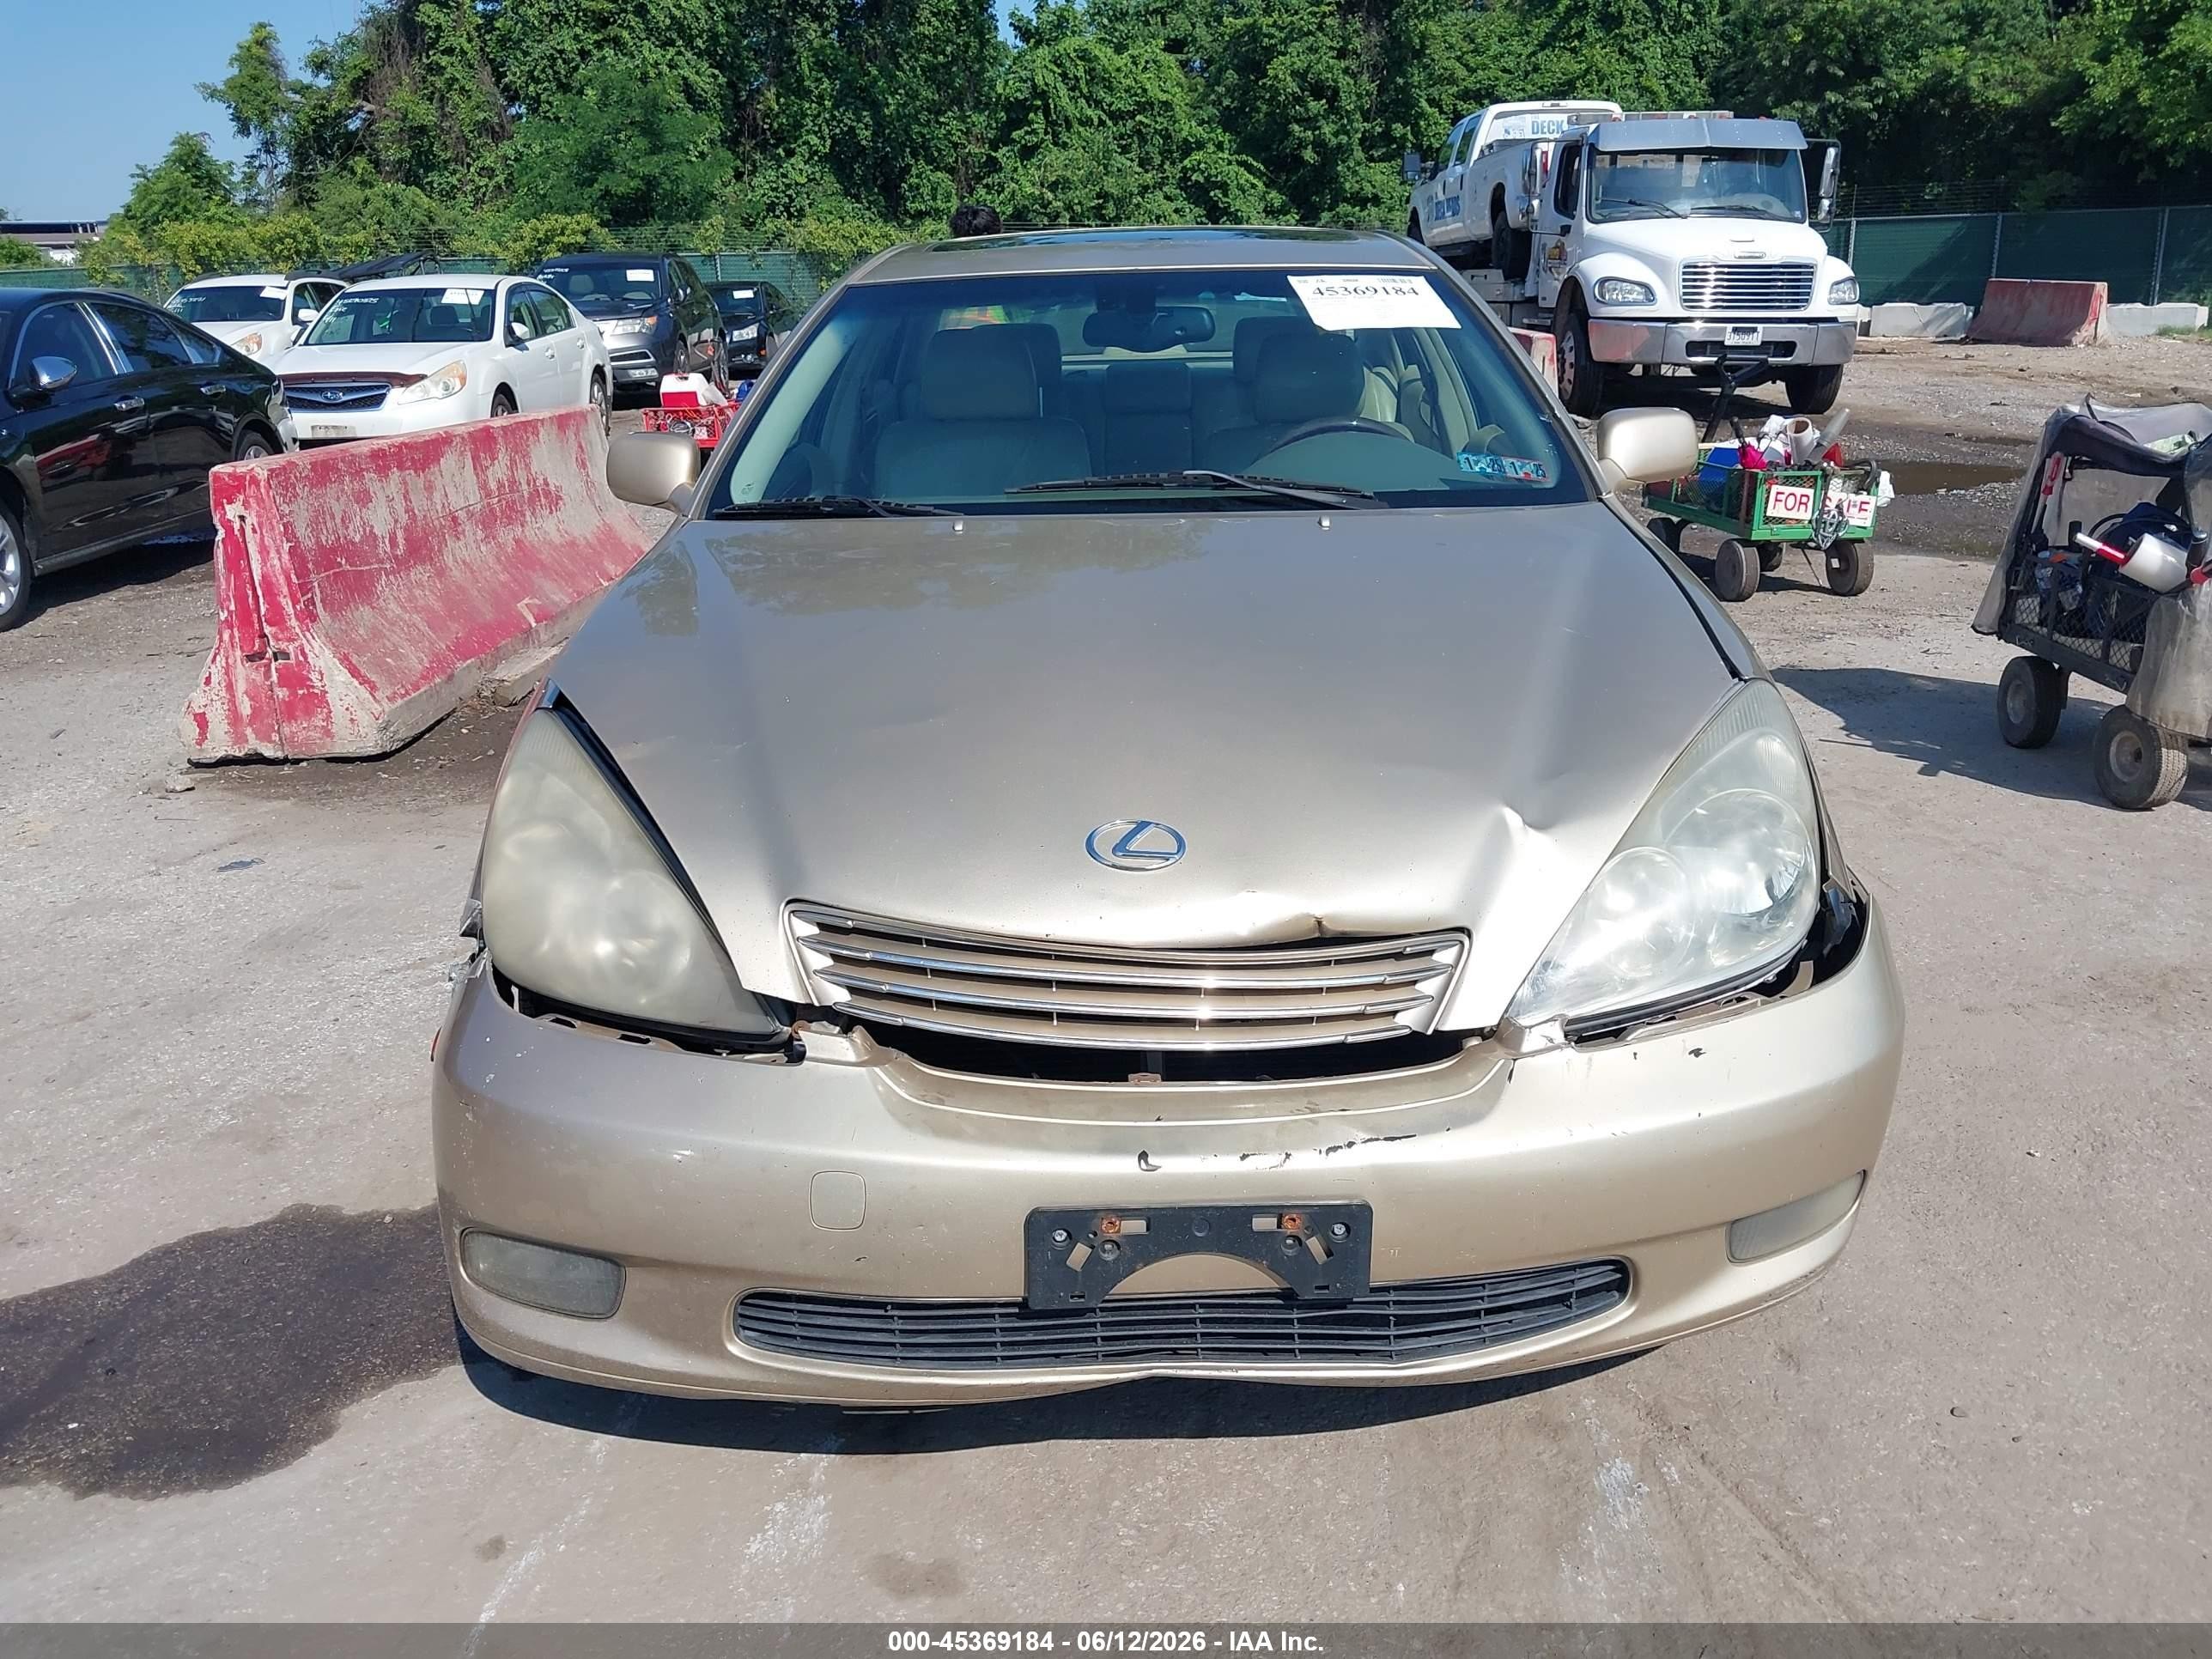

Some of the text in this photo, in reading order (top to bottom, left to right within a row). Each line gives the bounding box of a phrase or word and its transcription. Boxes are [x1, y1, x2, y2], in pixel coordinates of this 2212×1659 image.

[1531, 119, 1565, 136] DECK
[1312, 285, 1419, 296] 45369184
[1773, 492, 1810, 513] FOR
